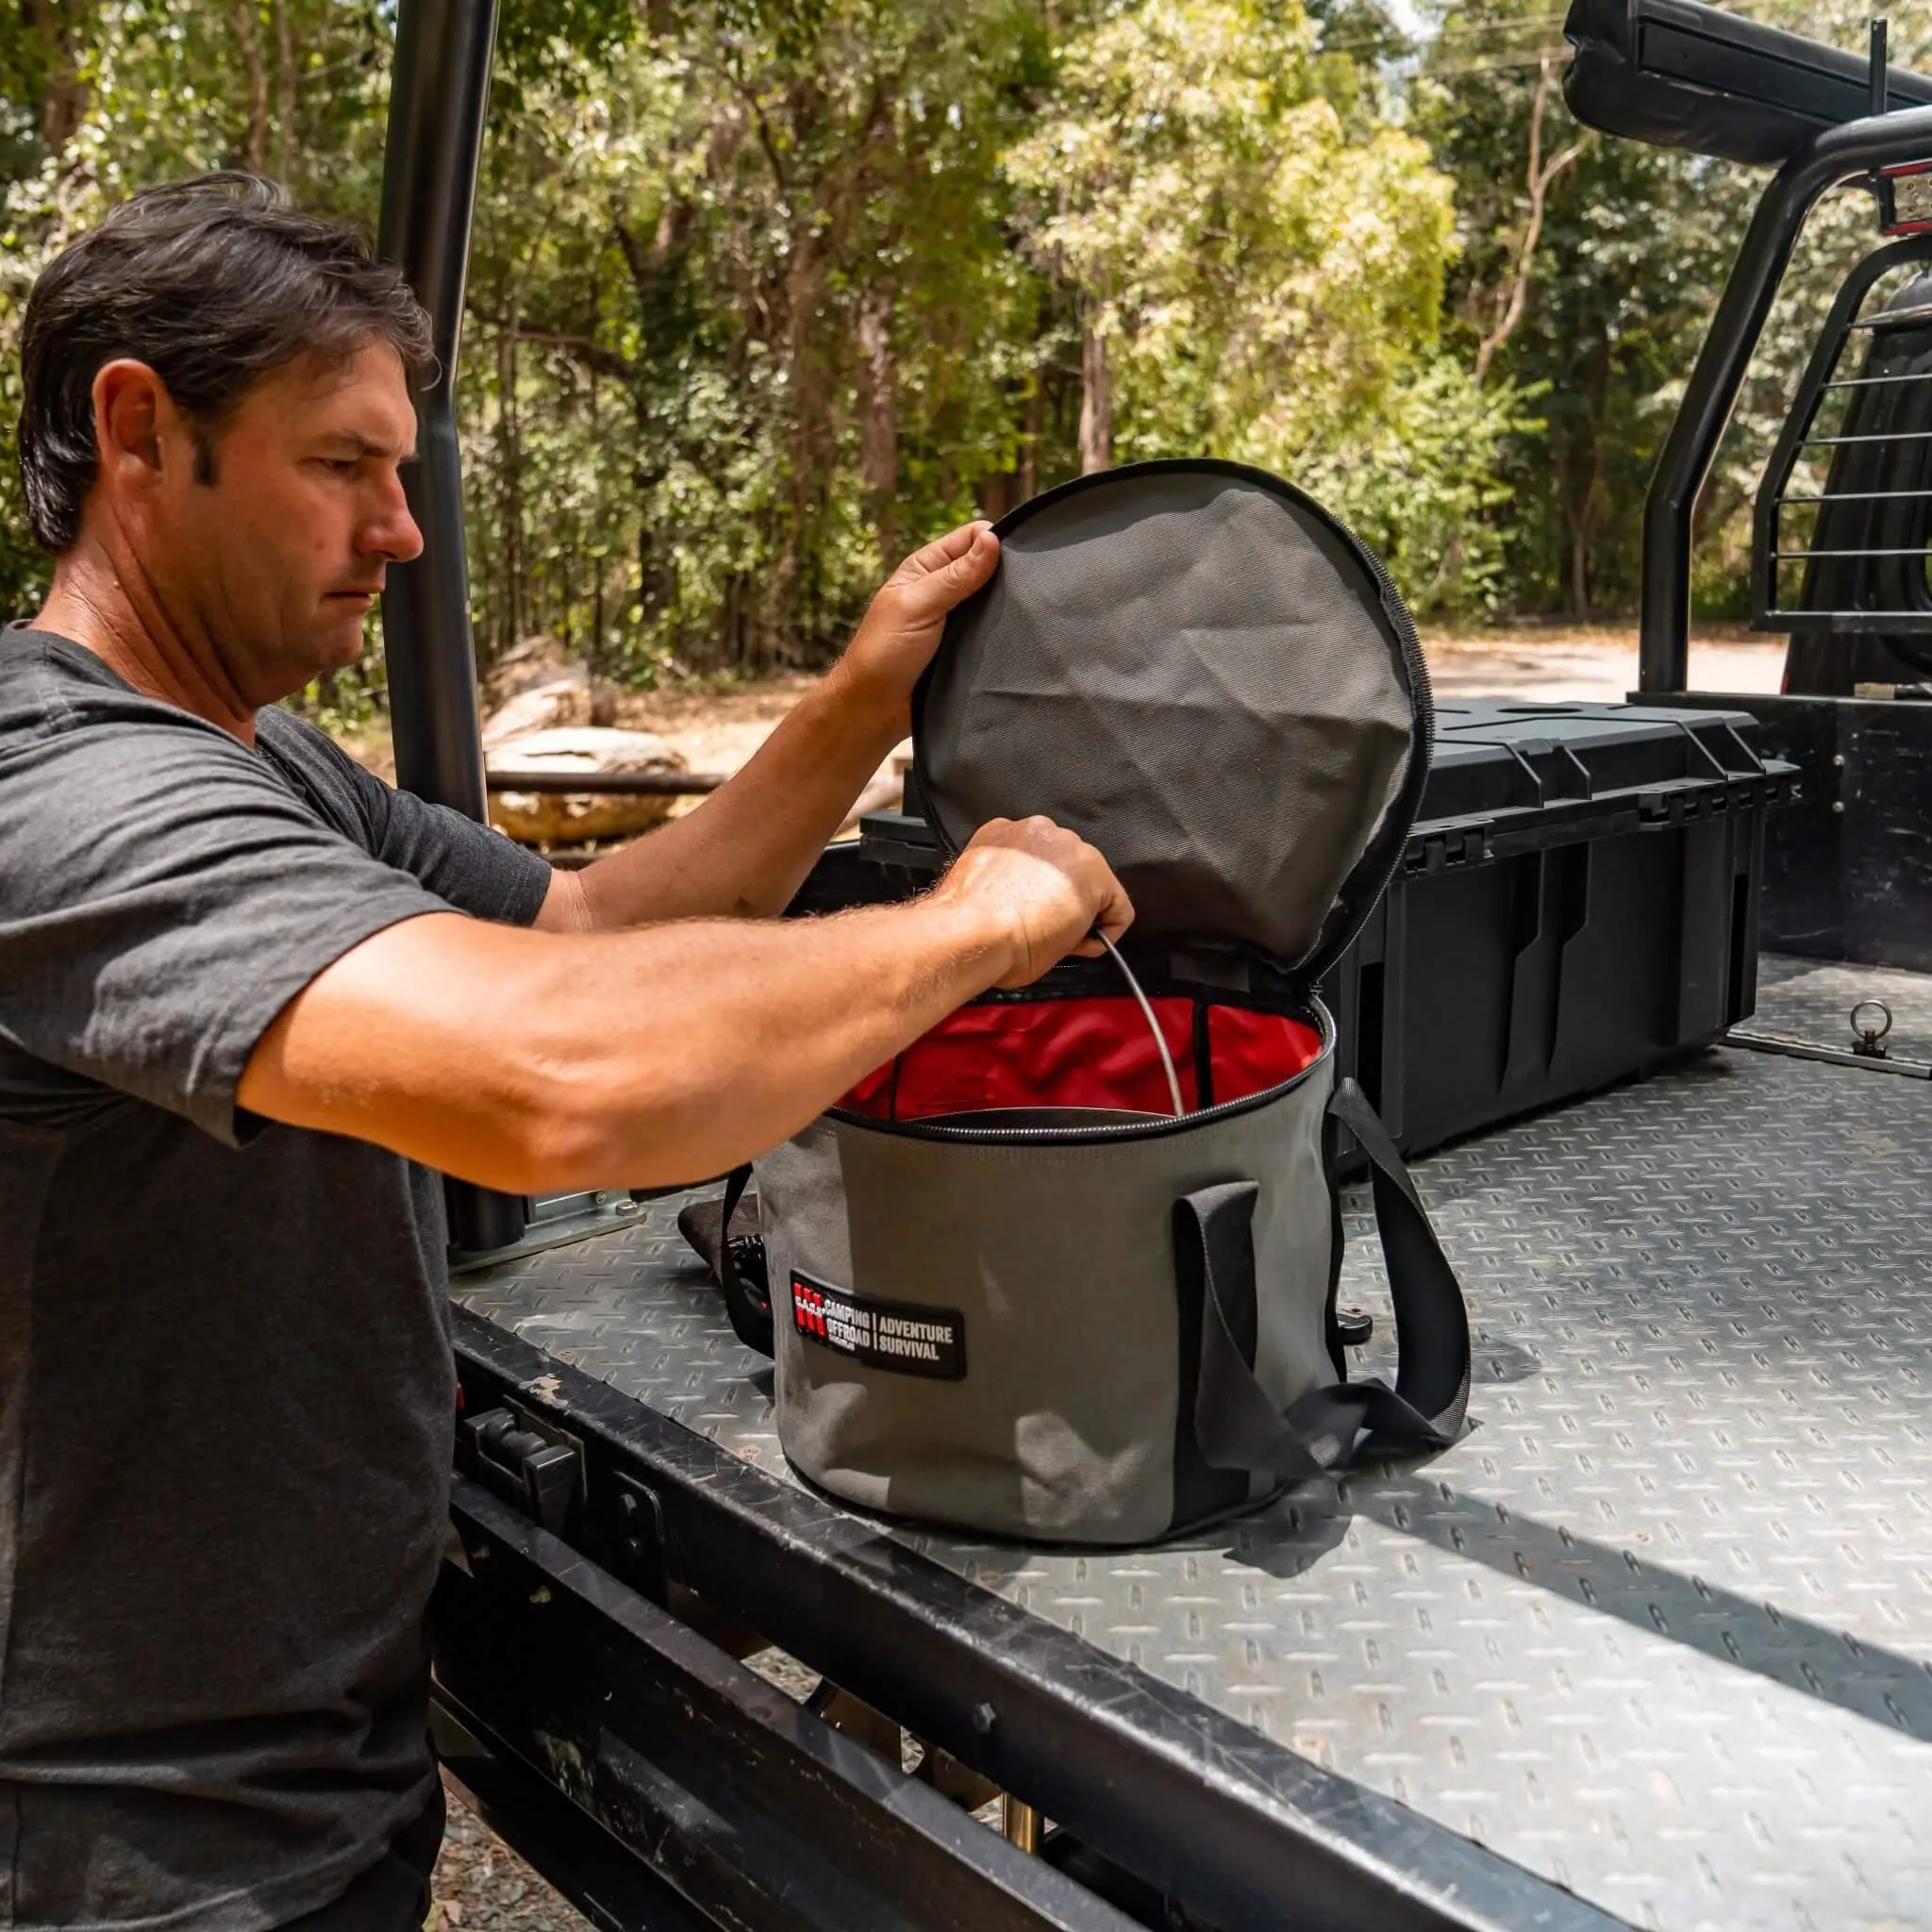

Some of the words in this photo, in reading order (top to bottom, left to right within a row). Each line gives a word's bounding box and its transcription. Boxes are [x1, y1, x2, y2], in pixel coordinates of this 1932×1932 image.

[824, 1298, 870, 1328] CAMPING
[879, 1316, 953, 1343] ADVENTURE
[826, 1318, 871, 1348] OFFROAD
[879, 1335, 940, 1360] SURVIVAL
